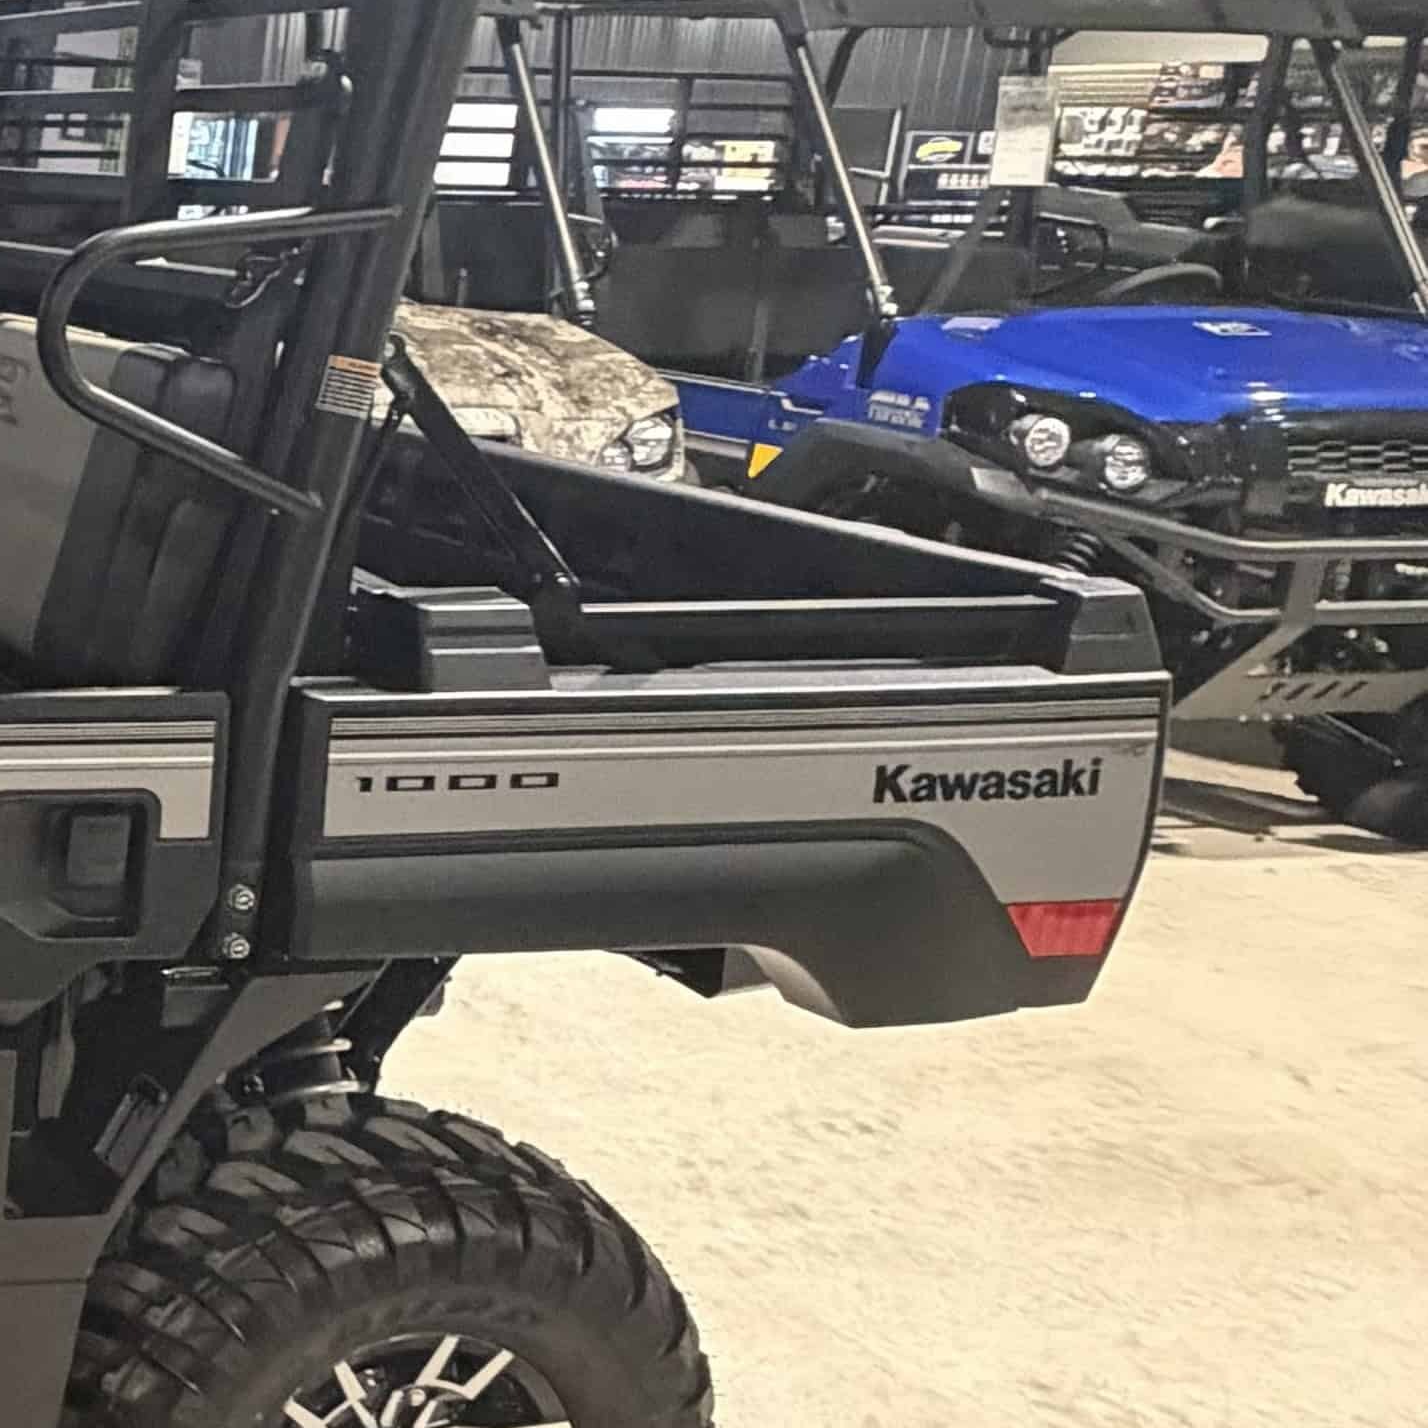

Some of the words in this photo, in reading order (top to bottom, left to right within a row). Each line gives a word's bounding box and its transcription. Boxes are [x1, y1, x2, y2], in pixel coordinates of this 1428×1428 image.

[1325, 483, 1428, 507] Kawasa
[355, 772, 560, 793] 1000
[872, 756, 1104, 804] Kawasaki
